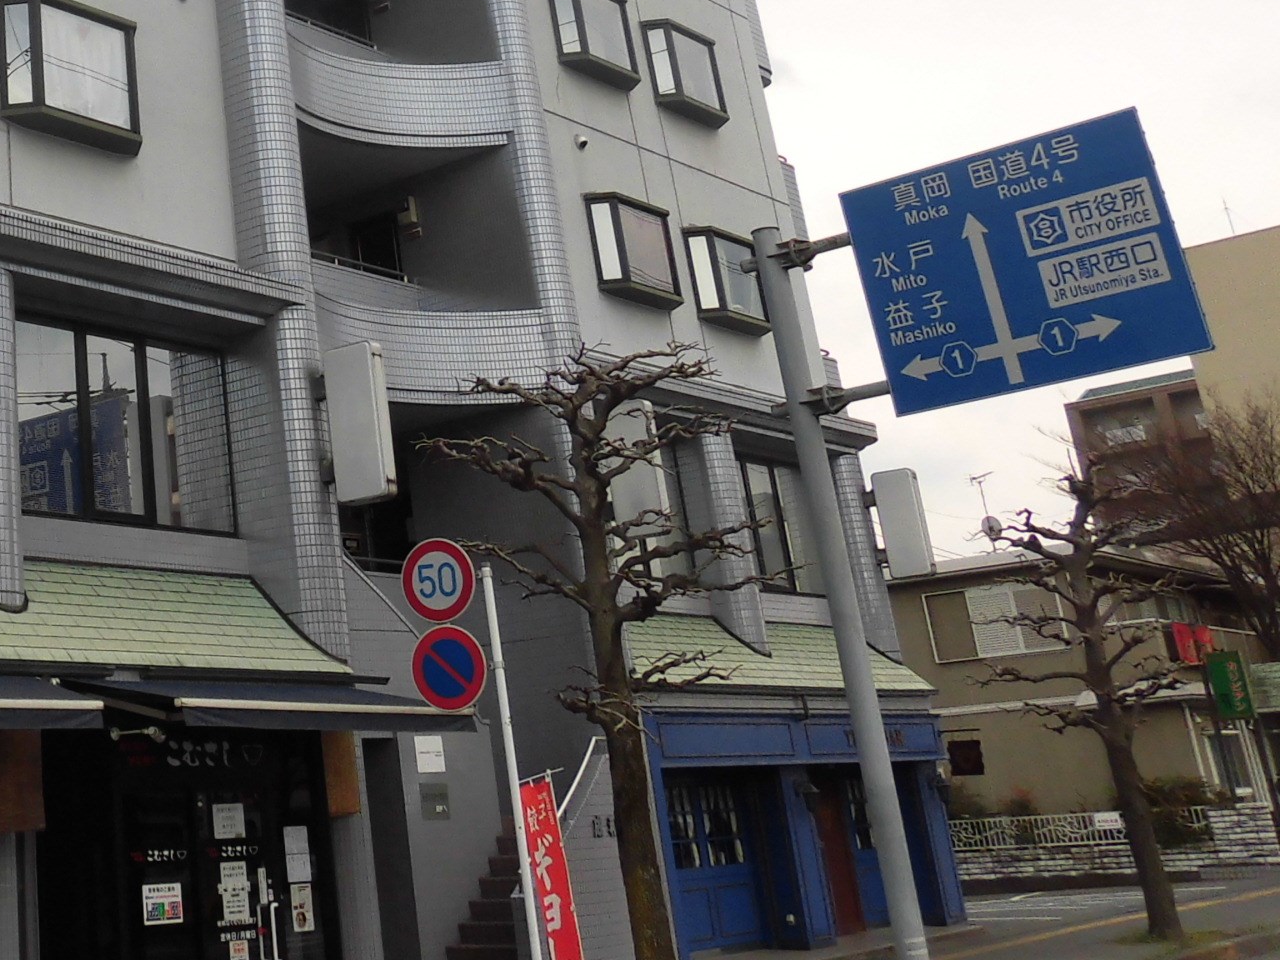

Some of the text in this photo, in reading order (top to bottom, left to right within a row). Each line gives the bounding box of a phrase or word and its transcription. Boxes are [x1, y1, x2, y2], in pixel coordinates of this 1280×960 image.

[967, 134, 1079, 189] 国道4号
[890, 172, 951, 212] 真岡
[998, 169, 1064, 200] Route 4
[904, 204, 949, 226] Moka
[1066, 183, 1146, 224] 市役所
[1075, 209, 1152, 239] CITY OFFICE
[872, 240, 934, 278] 水戸
[1048, 241, 1157, 287] JR駅西口
[892, 274, 927, 293] Mito
[1054, 268, 1164, 302] JR Utsunomiya Sta.
[884, 290, 948, 330] 益子
[890, 321, 956, 346] Mashiko
[1051, 326, 1064, 347] 1
[951, 349, 965, 370] 1
[417, 562, 458, 599] 50
